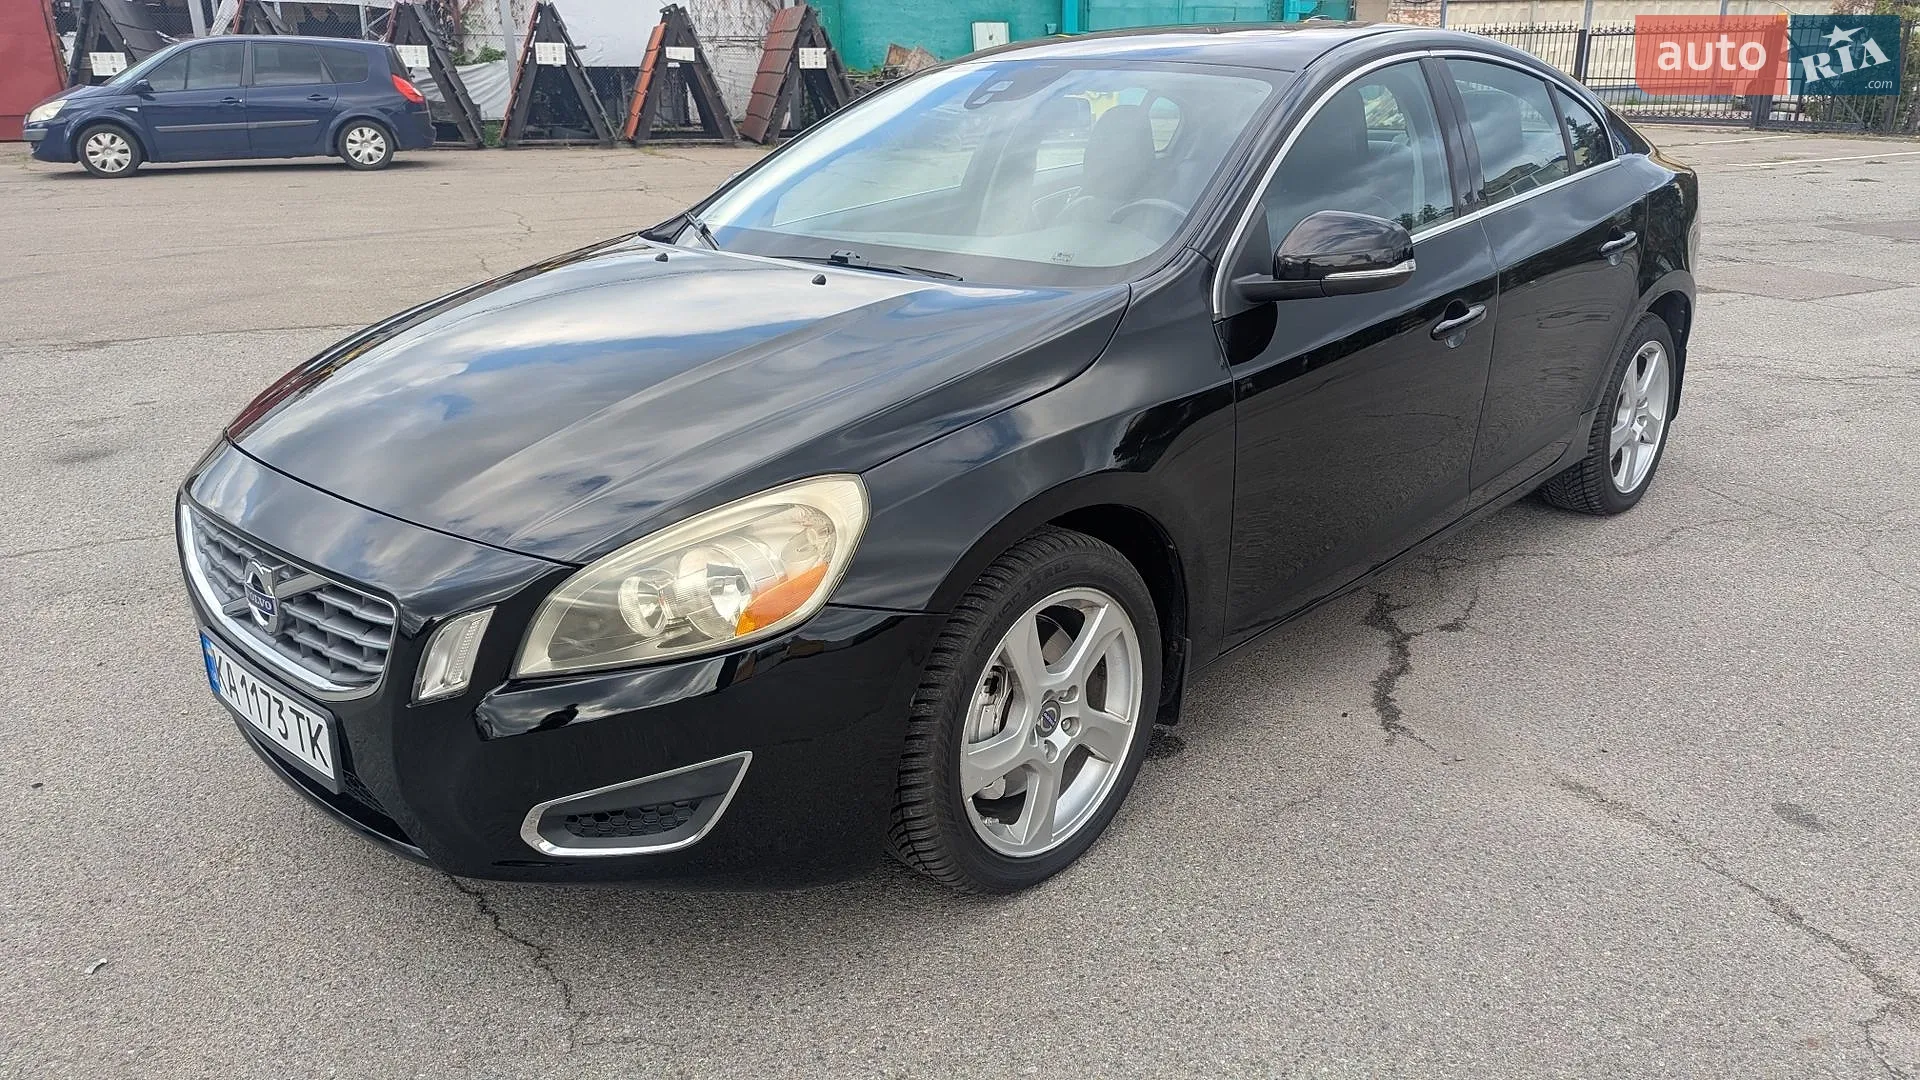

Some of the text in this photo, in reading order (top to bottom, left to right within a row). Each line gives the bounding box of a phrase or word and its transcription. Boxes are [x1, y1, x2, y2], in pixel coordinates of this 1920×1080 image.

[248, 589, 272, 610] OLVO
[212, 649, 330, 768] KA 1173 TK
